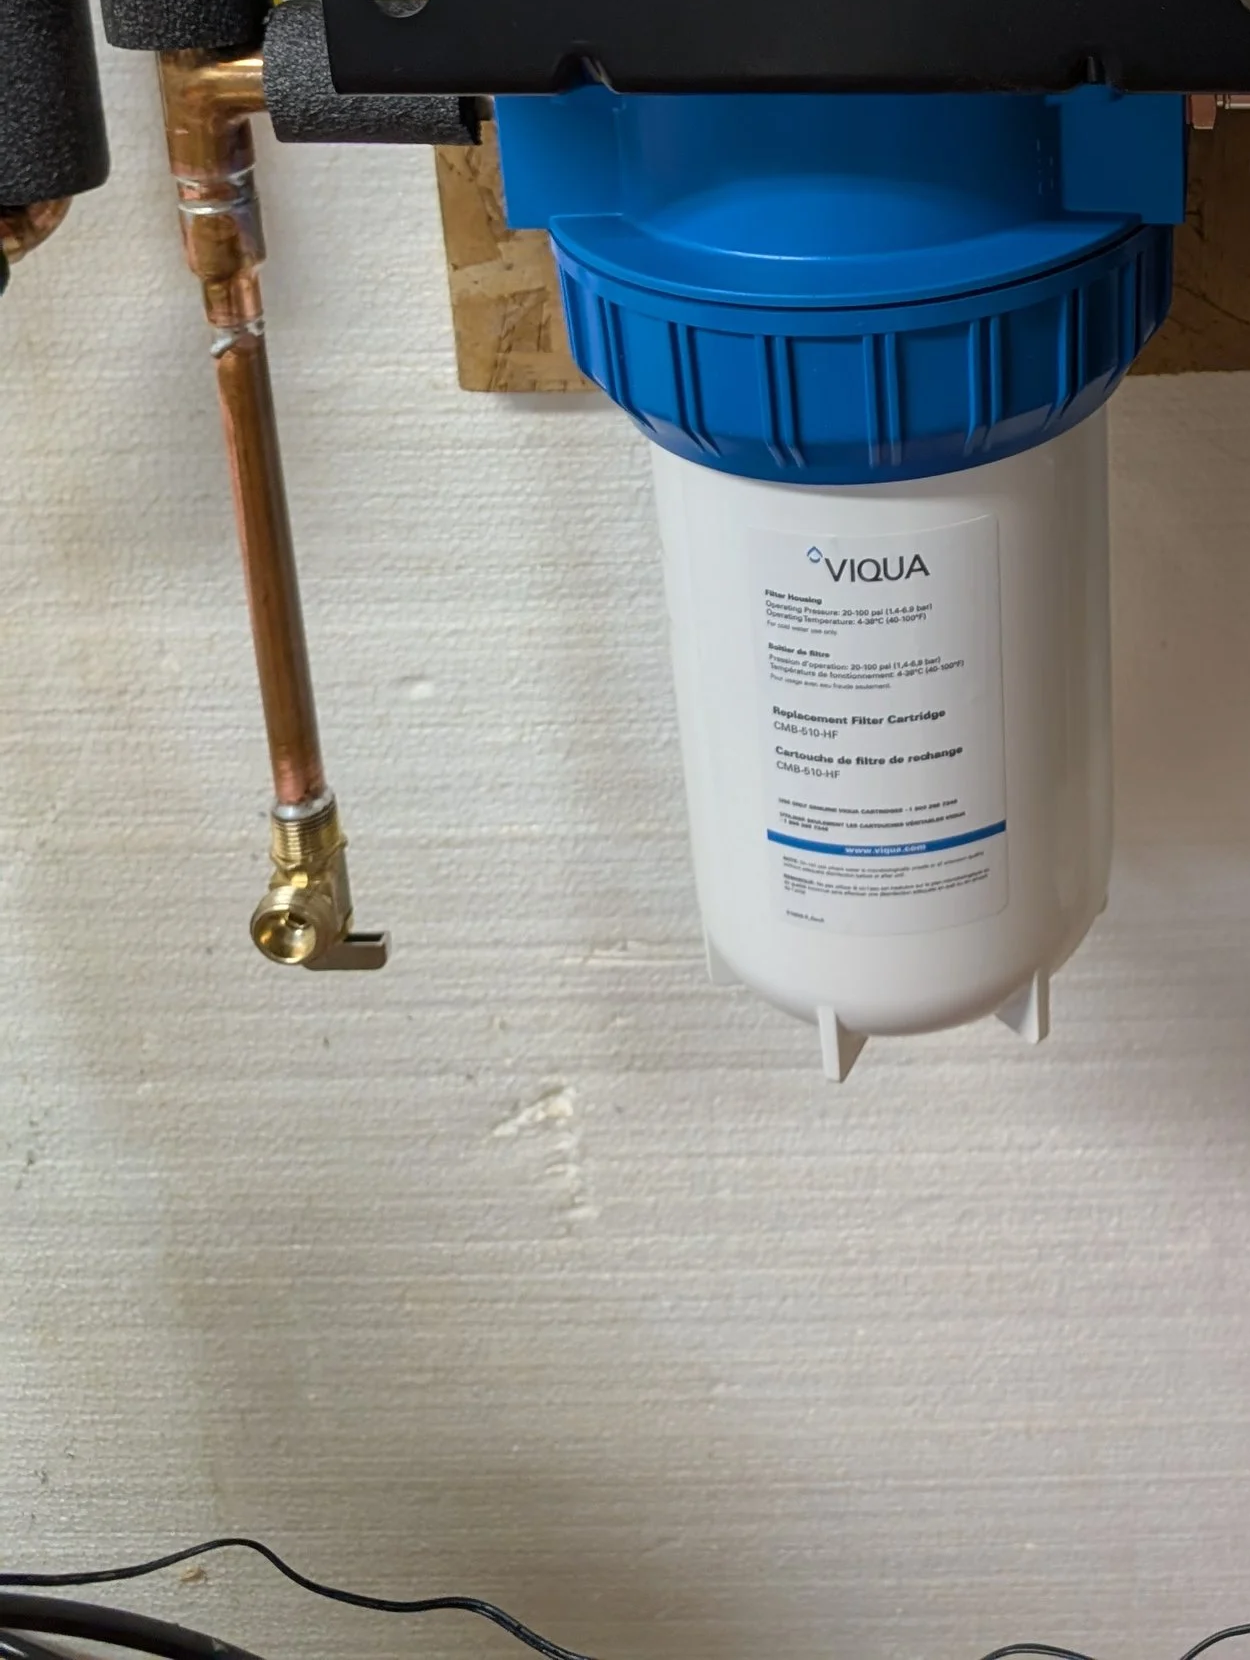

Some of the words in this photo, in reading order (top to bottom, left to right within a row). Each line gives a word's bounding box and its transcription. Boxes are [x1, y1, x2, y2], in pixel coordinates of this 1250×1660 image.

[824, 554, 930, 583] VIQUA
[765, 589, 786, 599] Filter
[788, 593, 822, 605] Housing
[766, 600, 803, 614] Operating
[804, 606, 840, 616] Pressure:
[766, 608, 803, 623] Operating
[803, 615, 855, 625] Temperature:
[773, 705, 847, 725] Replacement
[851, 716, 884, 725] Filter
[887, 709, 946, 724] Cartridge
[773, 720, 839, 740] CMB-510-HF
[775, 745, 833, 764] Cartouche
[837, 755, 851, 765] de
[855, 755, 885, 765] filtre
[889, 755, 904, 765] de
[908, 746, 963, 763] rechange
[776, 760, 840, 779] CMB-510-HF
[845, 844, 926, 855] www.viqua.com
